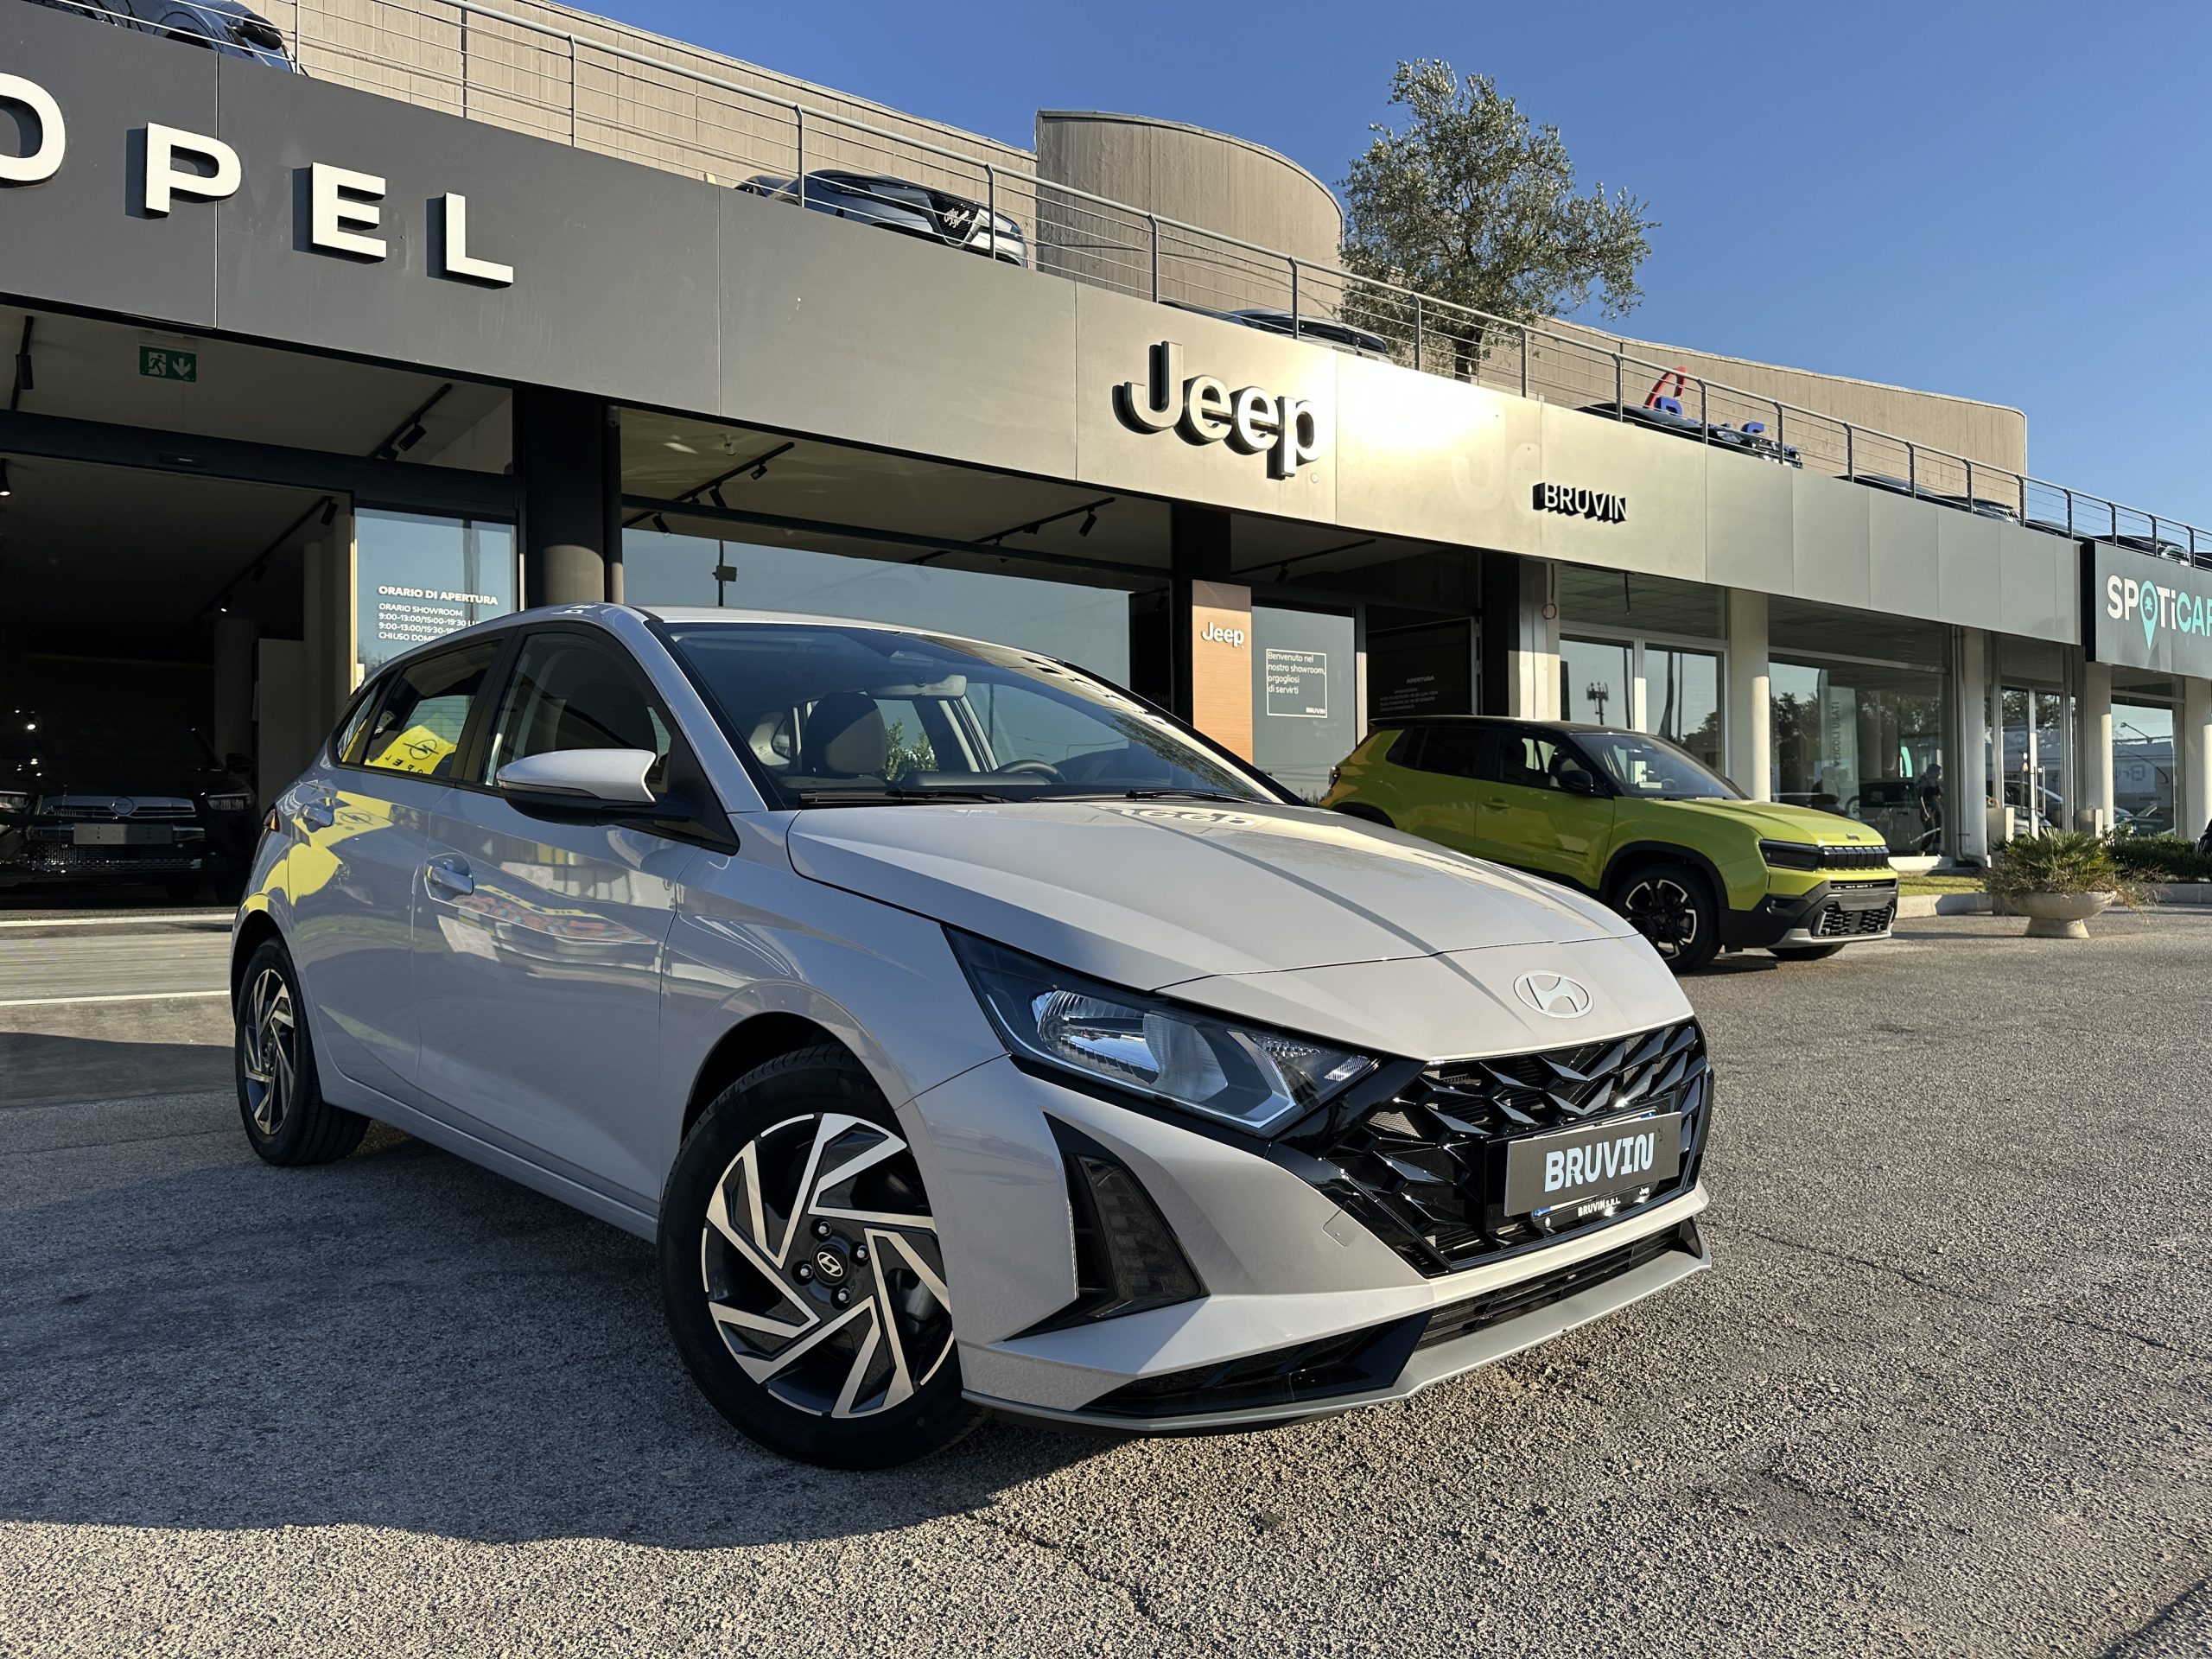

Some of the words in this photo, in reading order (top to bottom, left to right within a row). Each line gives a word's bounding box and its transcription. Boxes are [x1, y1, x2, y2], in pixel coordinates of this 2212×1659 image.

[1122, 340, 1323, 478] Jeep
[1541, 482, 1629, 522] BRUVIN
[378, 586, 423, 598] ORARIO
[425, 589, 438, 599] DI
[439, 592, 499, 605] APERTURA
[378, 603, 410, 613] ORARIO
[412, 607, 463, 617] SHOWROOM
[378, 632, 410, 641] CHIUSO
[1201, 622, 1245, 648] Jeep
[1268, 652, 1303, 662] Benvenuto
[1304, 654, 1314, 663] nel
[1268, 675, 1300, 684] orgogliosi
[1268, 684, 1274, 693] di
[1275, 685, 1299, 695] servirti
[1831, 702, 1840, 728] USATI
[1544, 1132, 1655, 1192] BRUVIN
[1578, 1199, 1605, 1217] BRUVIN
